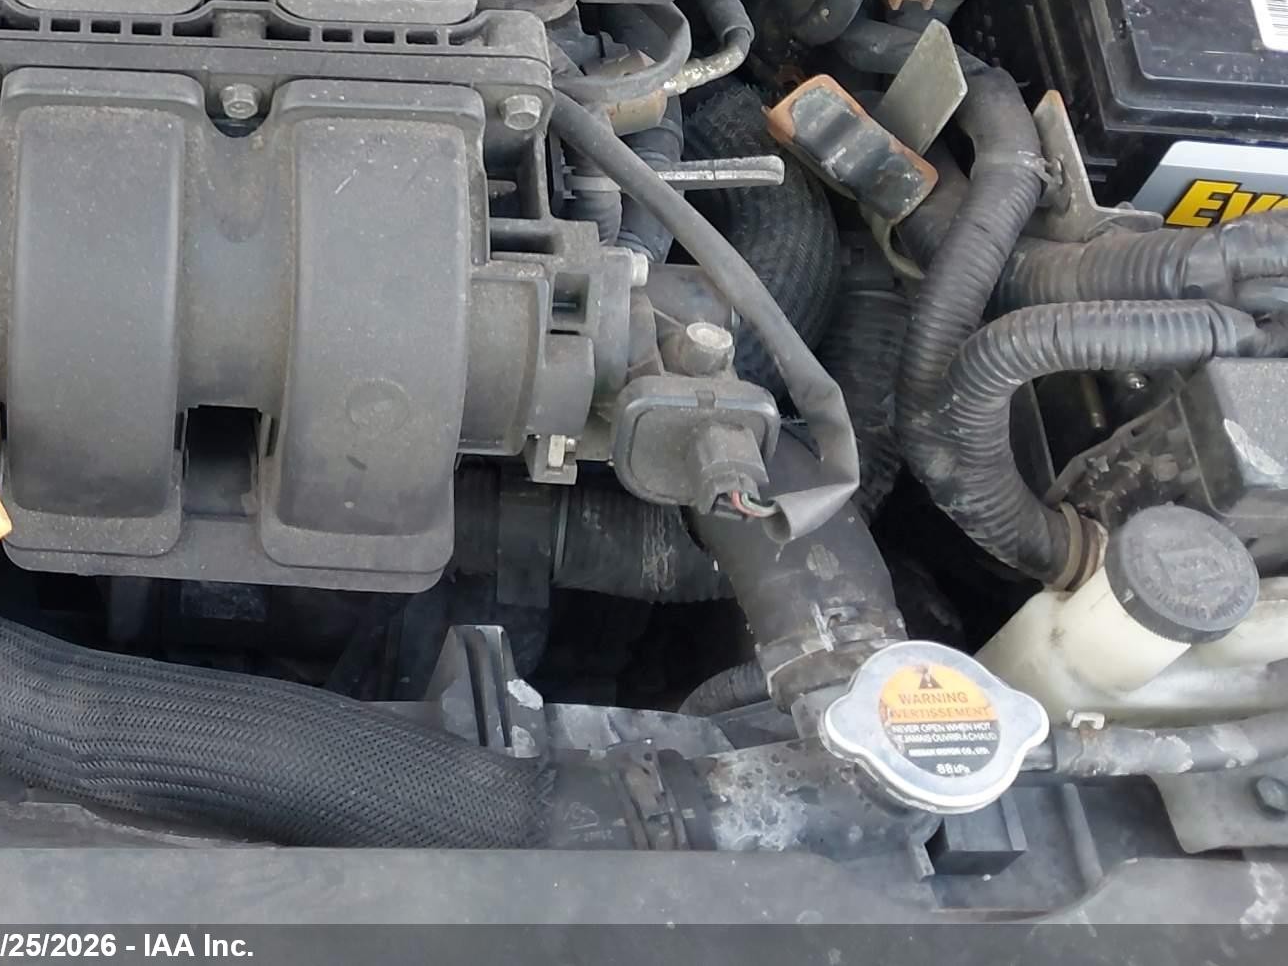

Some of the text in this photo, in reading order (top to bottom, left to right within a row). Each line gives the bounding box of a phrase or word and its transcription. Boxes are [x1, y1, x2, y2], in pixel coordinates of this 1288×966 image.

[898, 691, 969, 705] WARNING
[891, 721, 991, 733] NEVER OPEN WHEN HOT
